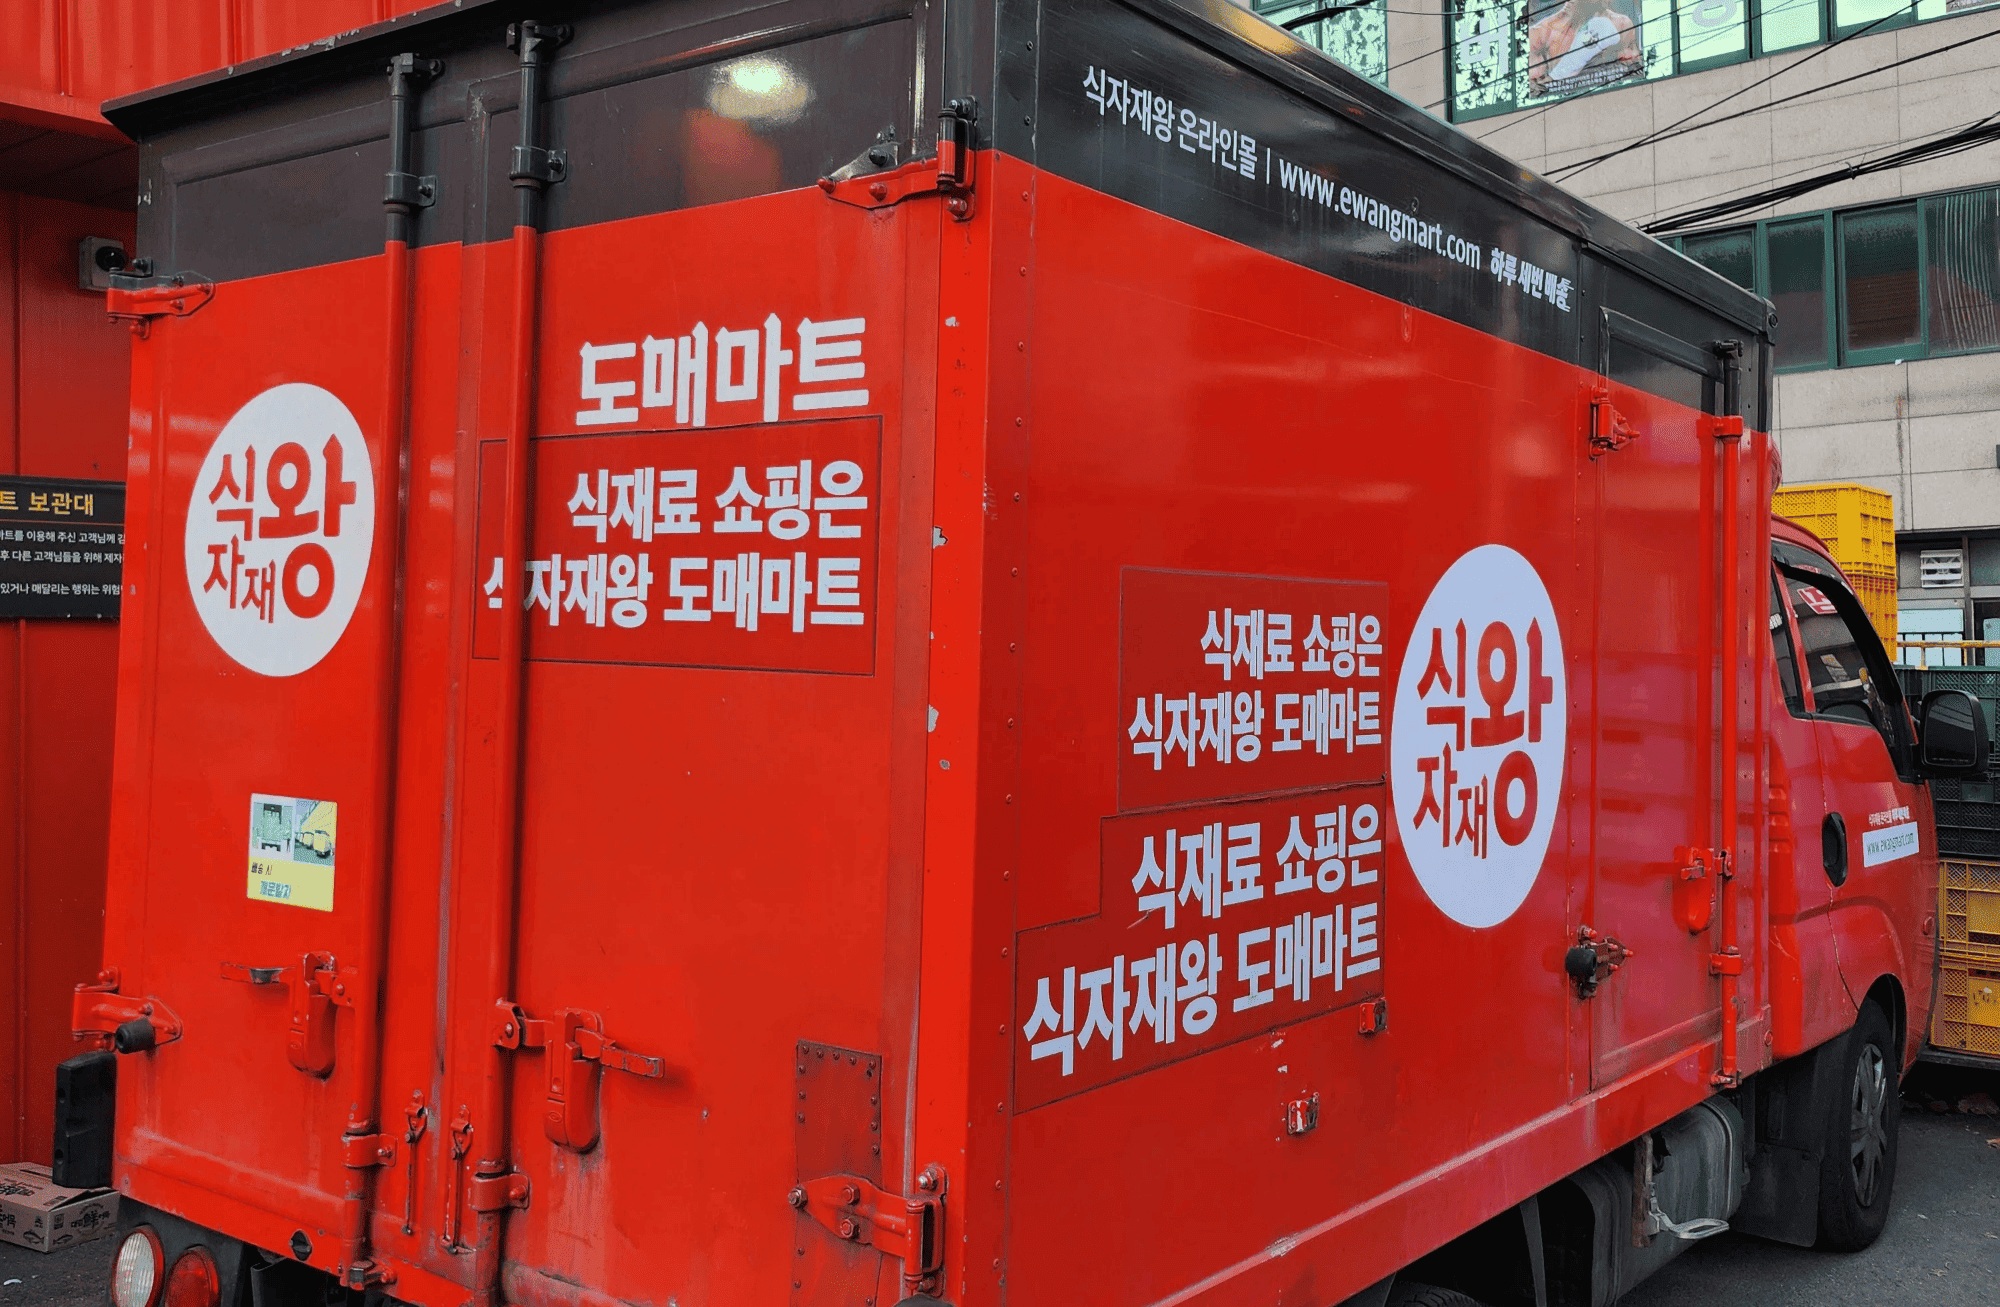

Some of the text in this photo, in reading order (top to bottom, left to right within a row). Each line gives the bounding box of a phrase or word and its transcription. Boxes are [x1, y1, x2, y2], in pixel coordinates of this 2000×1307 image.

[1082, 65, 1176, 143] 식자재왕
[1177, 107, 1257, 182] 온라인몰
[1279, 158, 1482, 271] www.ewangmart.com
[1490, 247, 1518, 287] 하루
[1517, 260, 1545, 299] 세번
[575, 312, 869, 427] 도매마트
[0, 529, 25, 542] 트를
[26, 530, 56, 542] 이용해
[57, 531, 77, 543] 주신
[78, 533, 116, 545] 고객님께
[28, 492, 94, 516] 보관대
[567, 459, 869, 544] 식재료 쇼핑은
[0, 582, 124, 597] 있거나 매달리는 행위는 위험
[12, 550, 32, 563] 다른
[33, 551, 82, 564] 고객님들을
[83, 552, 103, 564] 위해
[103, 553, 125, 565] 제자
[663, 551, 865, 634] 도매마트
[1200, 607, 1384, 681] 식재료 쇼핑은
[1127, 686, 1383, 771] 식자재왕 도매마트
[1131, 803, 1382, 930] 식재료 쇼핑은
[1022, 902, 1381, 1077] 식자재왕 도매마트
